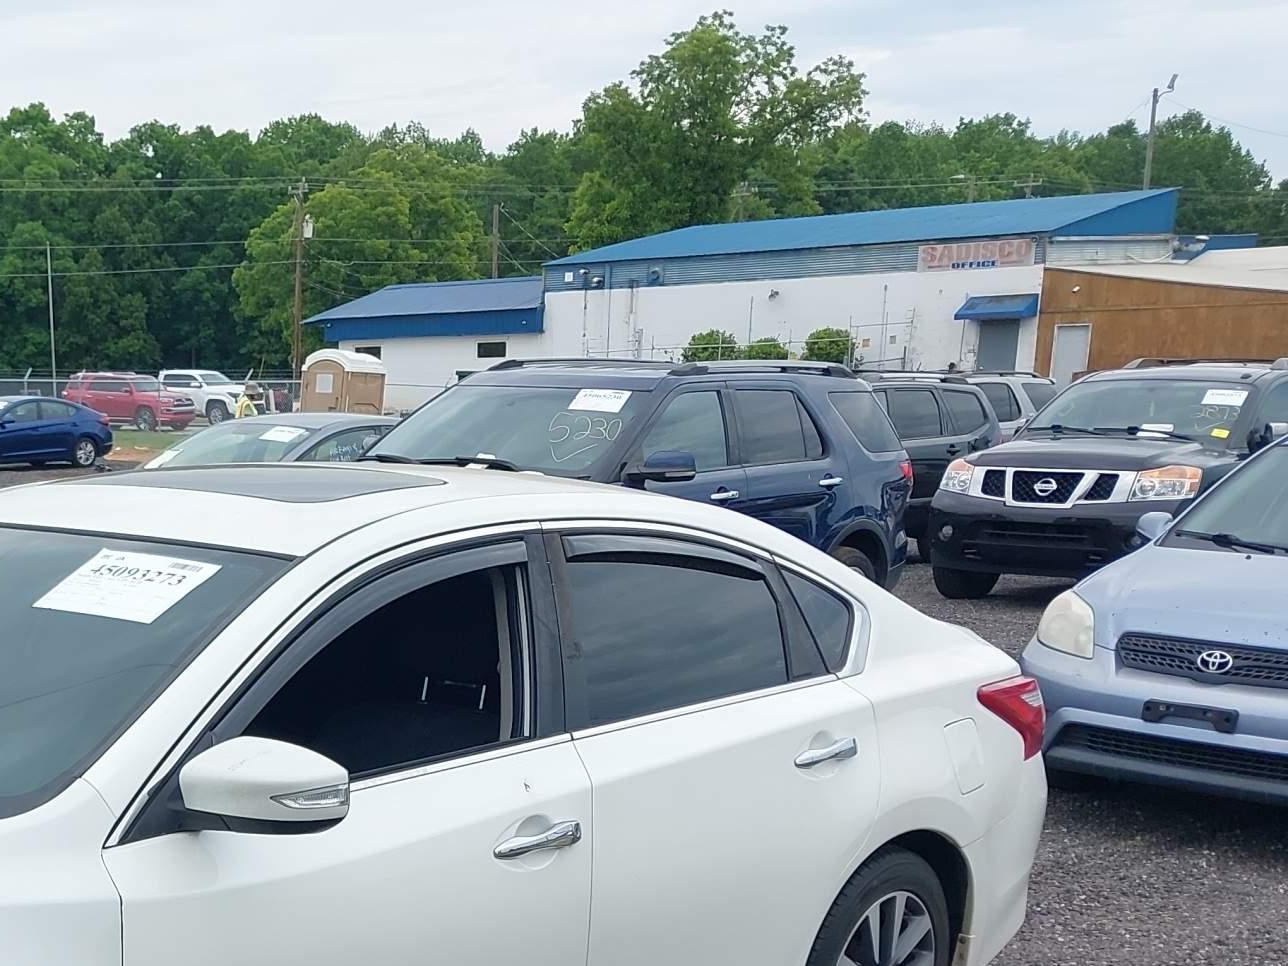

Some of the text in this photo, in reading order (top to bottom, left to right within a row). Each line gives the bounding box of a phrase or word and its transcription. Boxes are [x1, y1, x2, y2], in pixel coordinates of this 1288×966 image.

[923, 241, 1032, 262] SADISCO
[952, 260, 998, 269] OFFICE
[549, 412, 622, 443] 5230
[90, 563, 187, 586] 45093273
